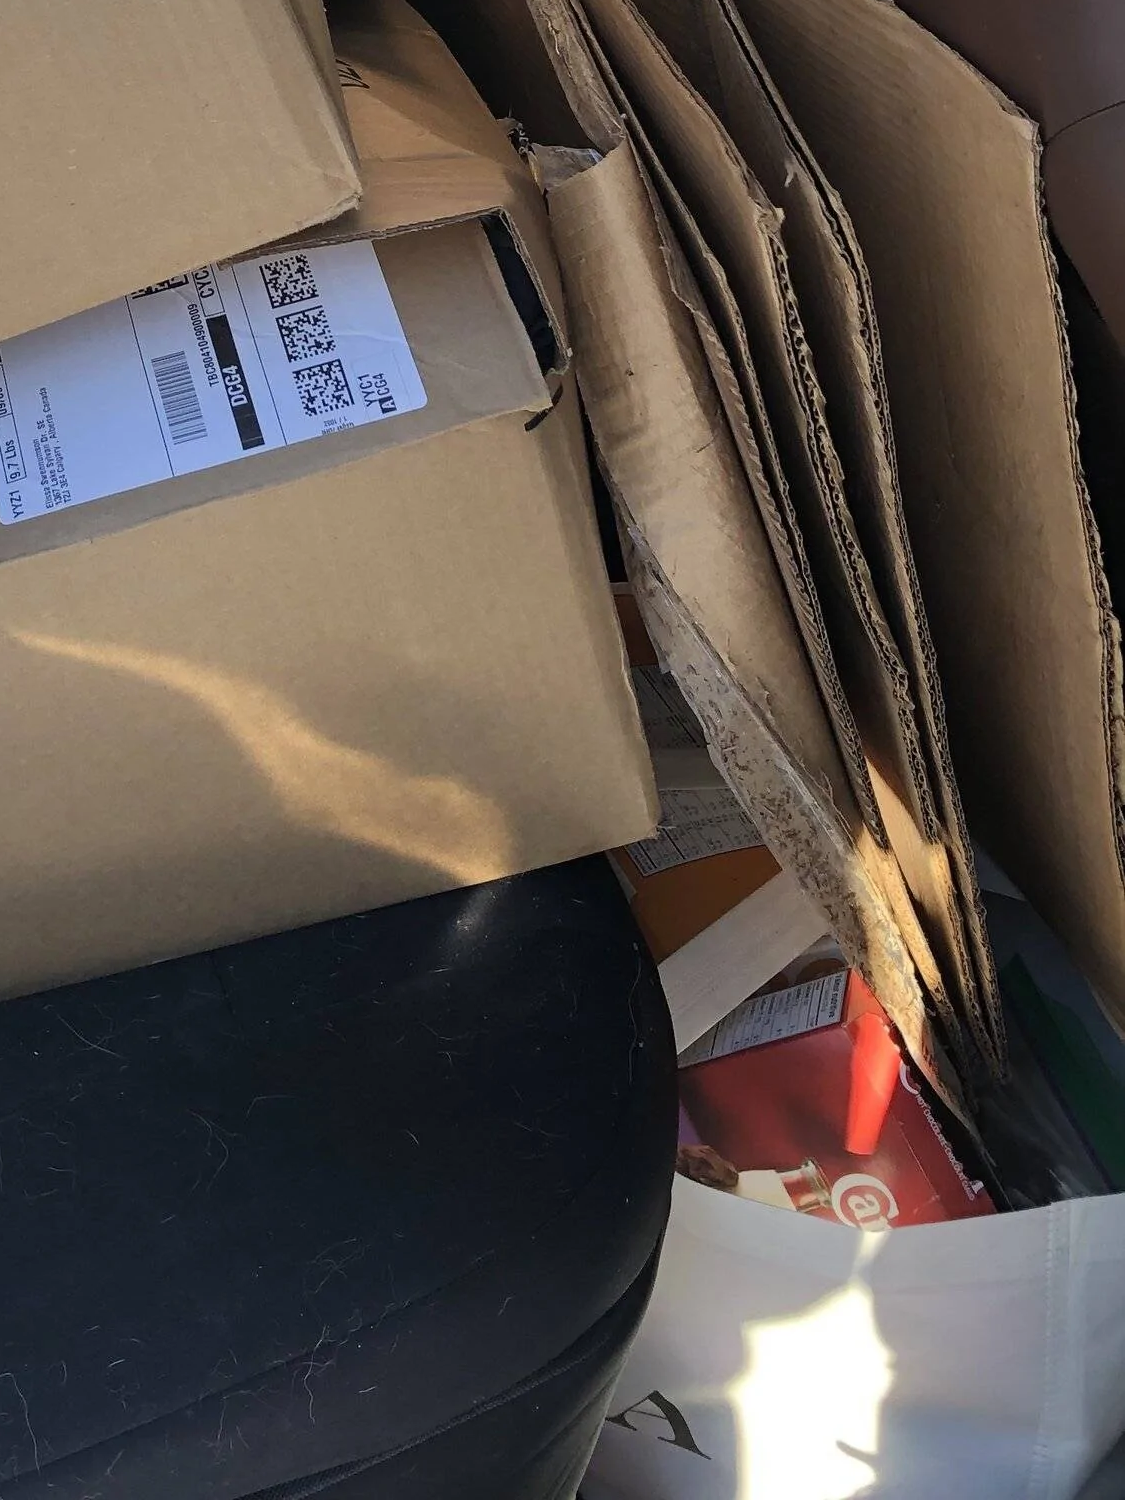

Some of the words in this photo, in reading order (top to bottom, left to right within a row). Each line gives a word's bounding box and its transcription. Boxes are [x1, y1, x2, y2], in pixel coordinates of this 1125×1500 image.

[222, 365, 248, 407] DCG4
[357, 373, 379, 407] YYC1
[39, 387, 51, 413] Canada
[46, 413, 57, 439] Alberta
[5, 439, 17, 460] Lbs
[53, 445, 65, 473] Calgary
[7, 462, 21, 480] 9.7
[9, 490, 25, 518] YYZ1
[915, 1093, 927, 1108] HOT
